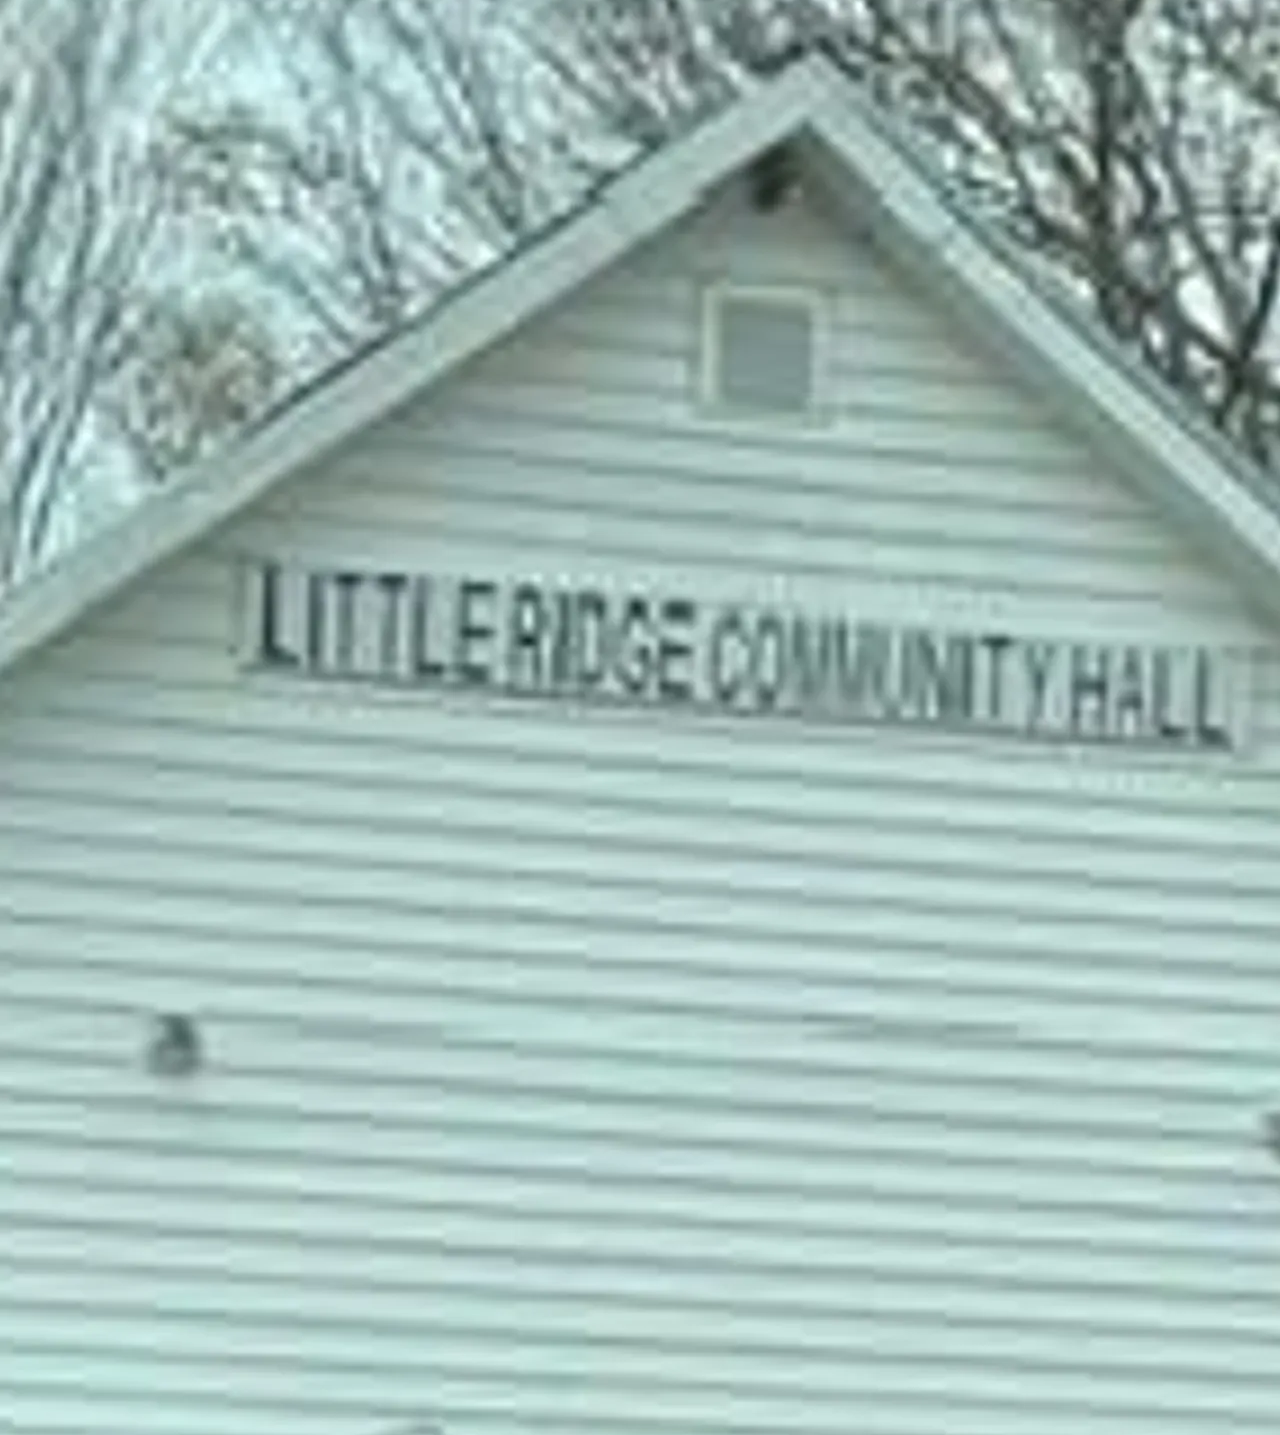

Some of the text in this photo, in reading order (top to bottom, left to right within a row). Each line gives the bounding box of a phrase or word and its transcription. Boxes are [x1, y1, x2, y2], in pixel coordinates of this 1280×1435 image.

[261, 560, 1236, 750] LITTLE RIDGE COMMUNITY HALL
